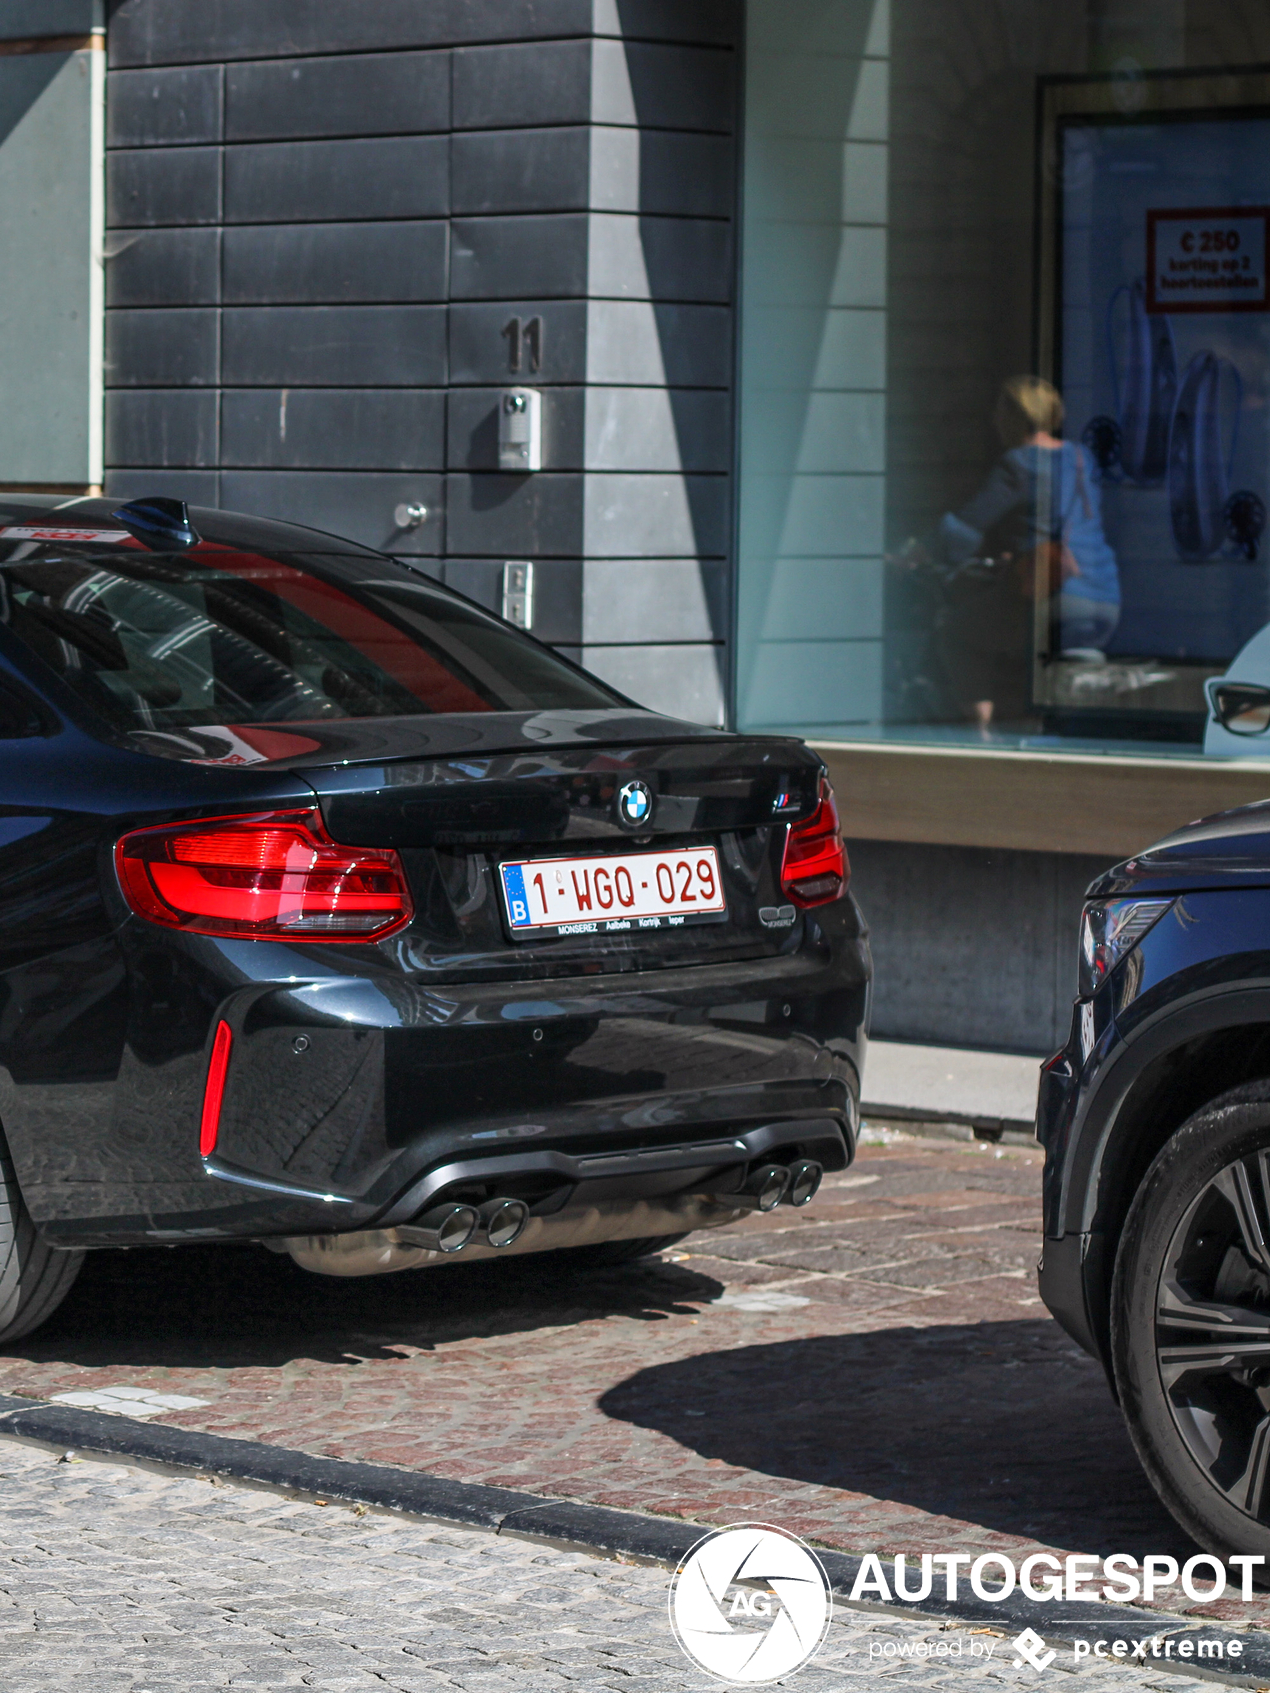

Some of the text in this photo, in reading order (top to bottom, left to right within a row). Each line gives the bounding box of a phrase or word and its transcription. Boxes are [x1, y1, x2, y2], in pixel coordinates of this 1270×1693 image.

[1199, 229, 1241, 253] 250
[1169, 256, 1219, 274] korting
[1222, 259, 1240, 273] op
[501, 316, 543, 375] 11
[511, 900, 527, 921] B
[557, 922, 599, 935] MONSEREZ
[638, 916, 662, 928] Kortrijk
